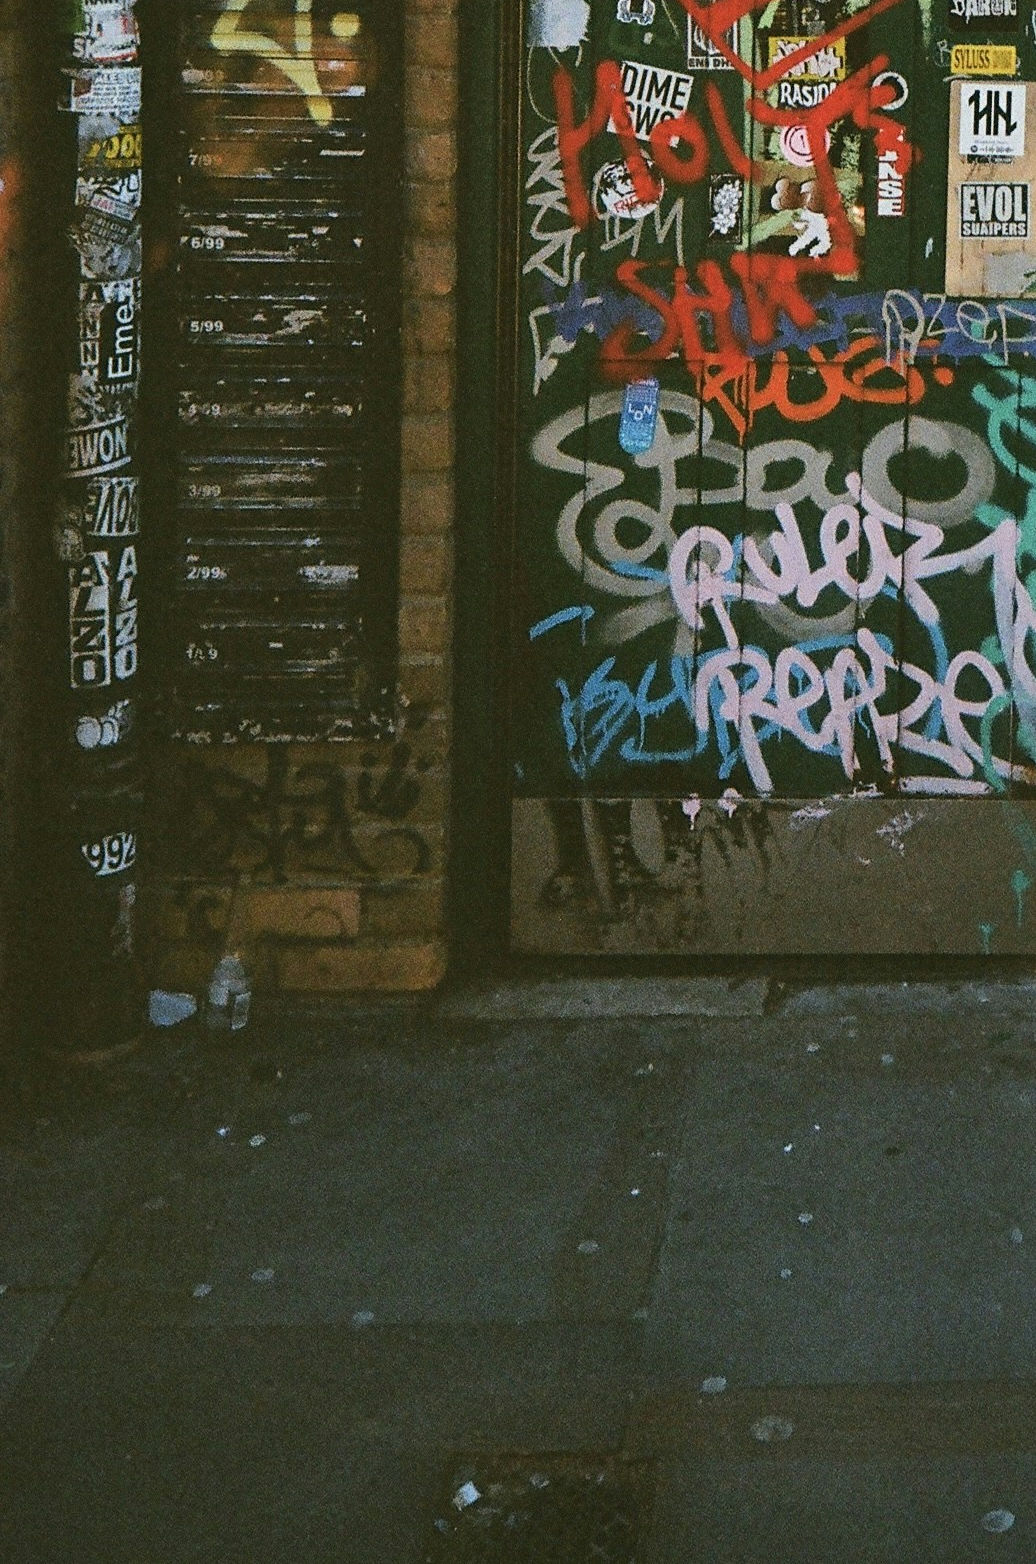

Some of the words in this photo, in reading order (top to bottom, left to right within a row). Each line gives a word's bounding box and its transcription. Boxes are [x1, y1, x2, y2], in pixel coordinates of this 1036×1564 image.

[953, 47, 991, 70] SYLUSS
[622, 64, 690, 111] DIME
[962, 184, 1027, 222] EVOL
[191, 237, 225, 250] 6/99
[189, 321, 224, 332] 5/99
[188, 485, 222, 498] 3/99
[187, 567, 221, 580] 2/99
